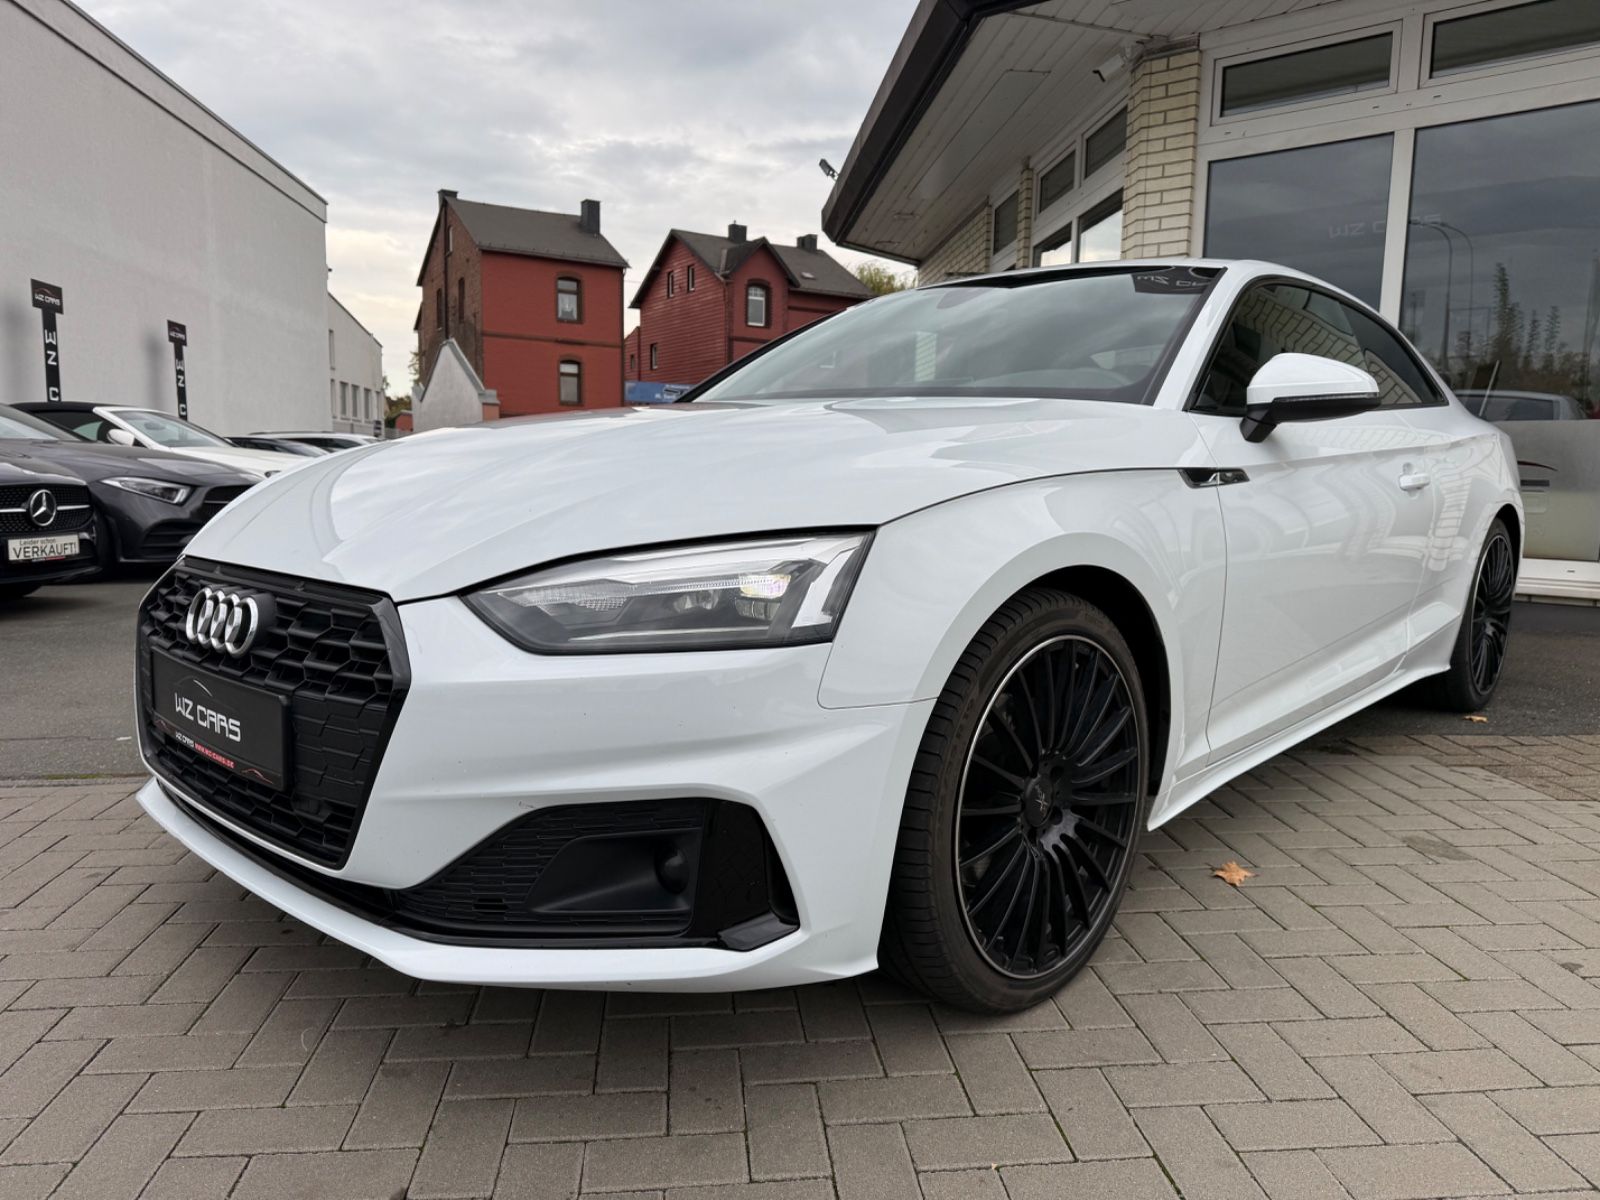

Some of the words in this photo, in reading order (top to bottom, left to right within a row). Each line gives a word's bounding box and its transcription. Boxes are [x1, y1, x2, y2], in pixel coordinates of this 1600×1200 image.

[13, 541, 76, 559] VERKAUFT!
[174, 692, 194, 721] WZ
[196, 704, 241, 742] CARS
